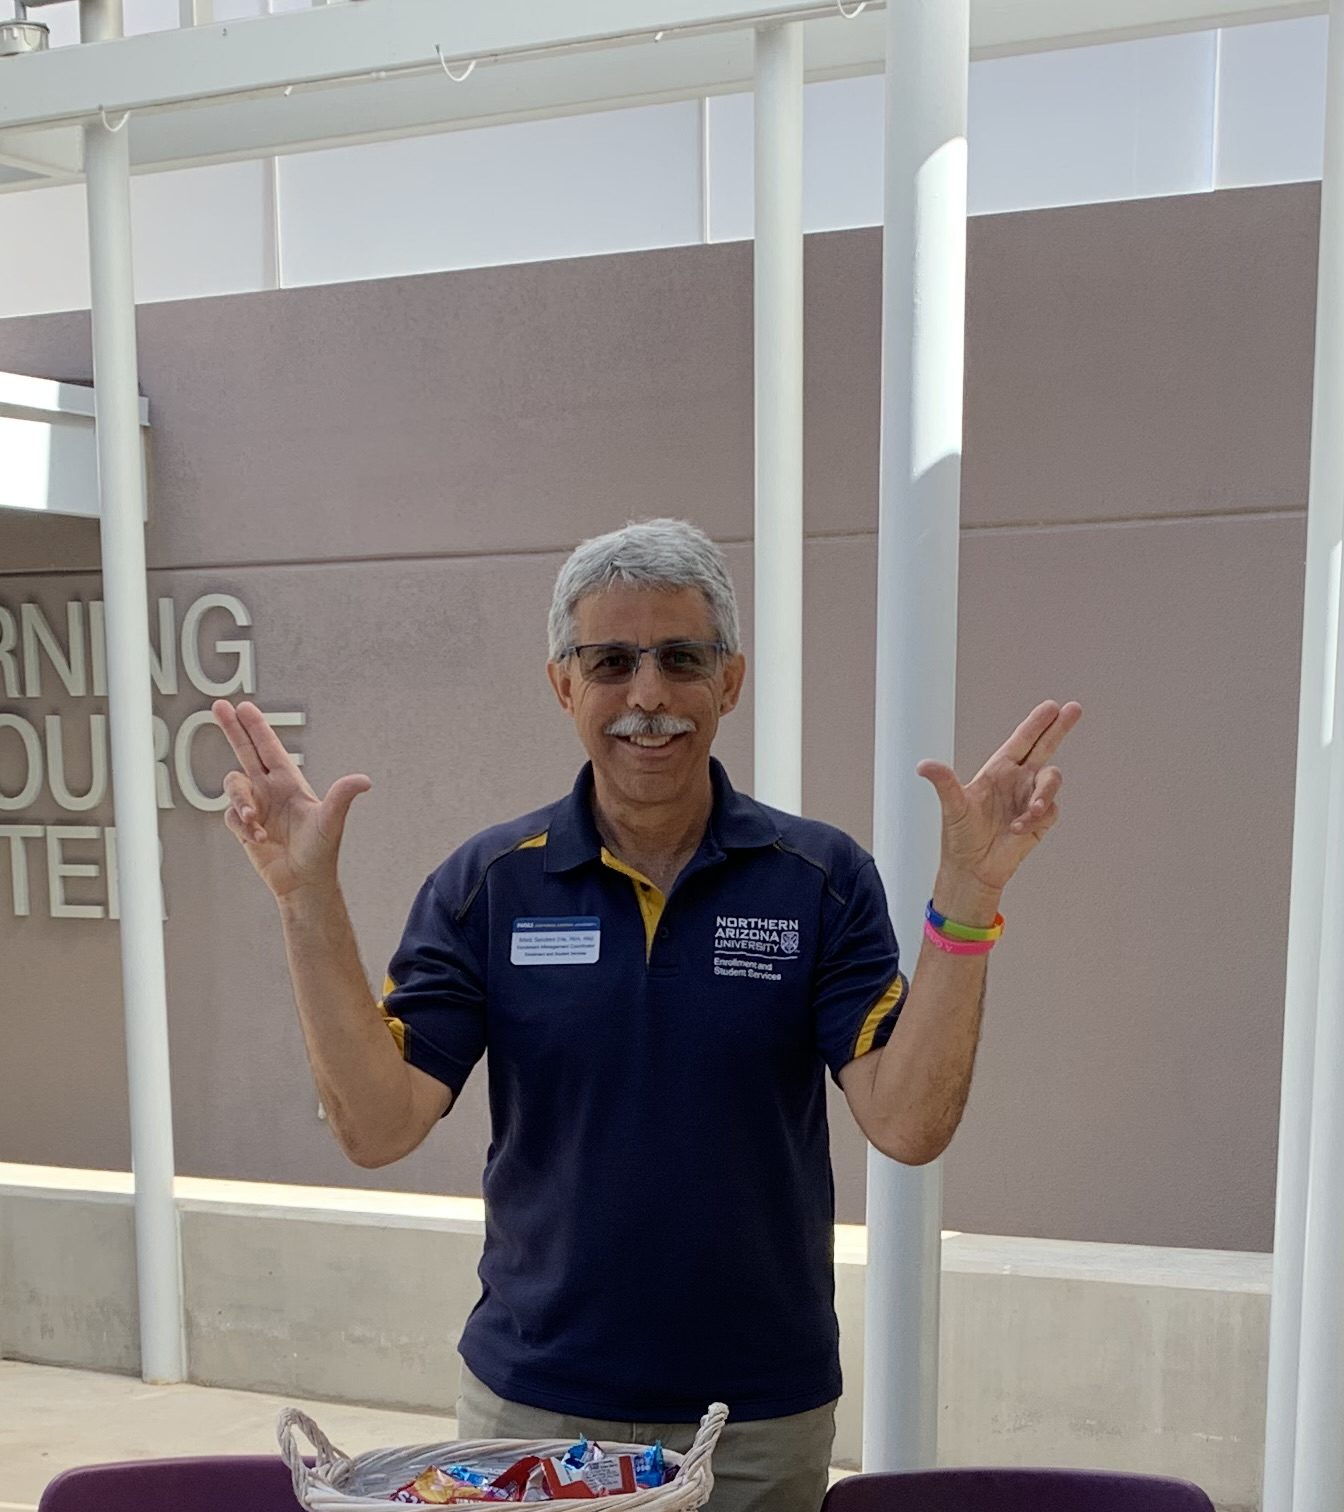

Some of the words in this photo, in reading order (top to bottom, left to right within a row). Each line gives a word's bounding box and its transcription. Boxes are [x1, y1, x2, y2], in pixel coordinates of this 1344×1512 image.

[716, 916, 799, 930] NORTHERN
[715, 928, 780, 942] ARIZONA
[715, 939, 779, 953] UNIVERSITY
[714, 957, 757, 968] Enrollment
[758, 963, 773, 971] and
[714, 966, 747, 977] Student
[748, 969, 782, 981] Services
